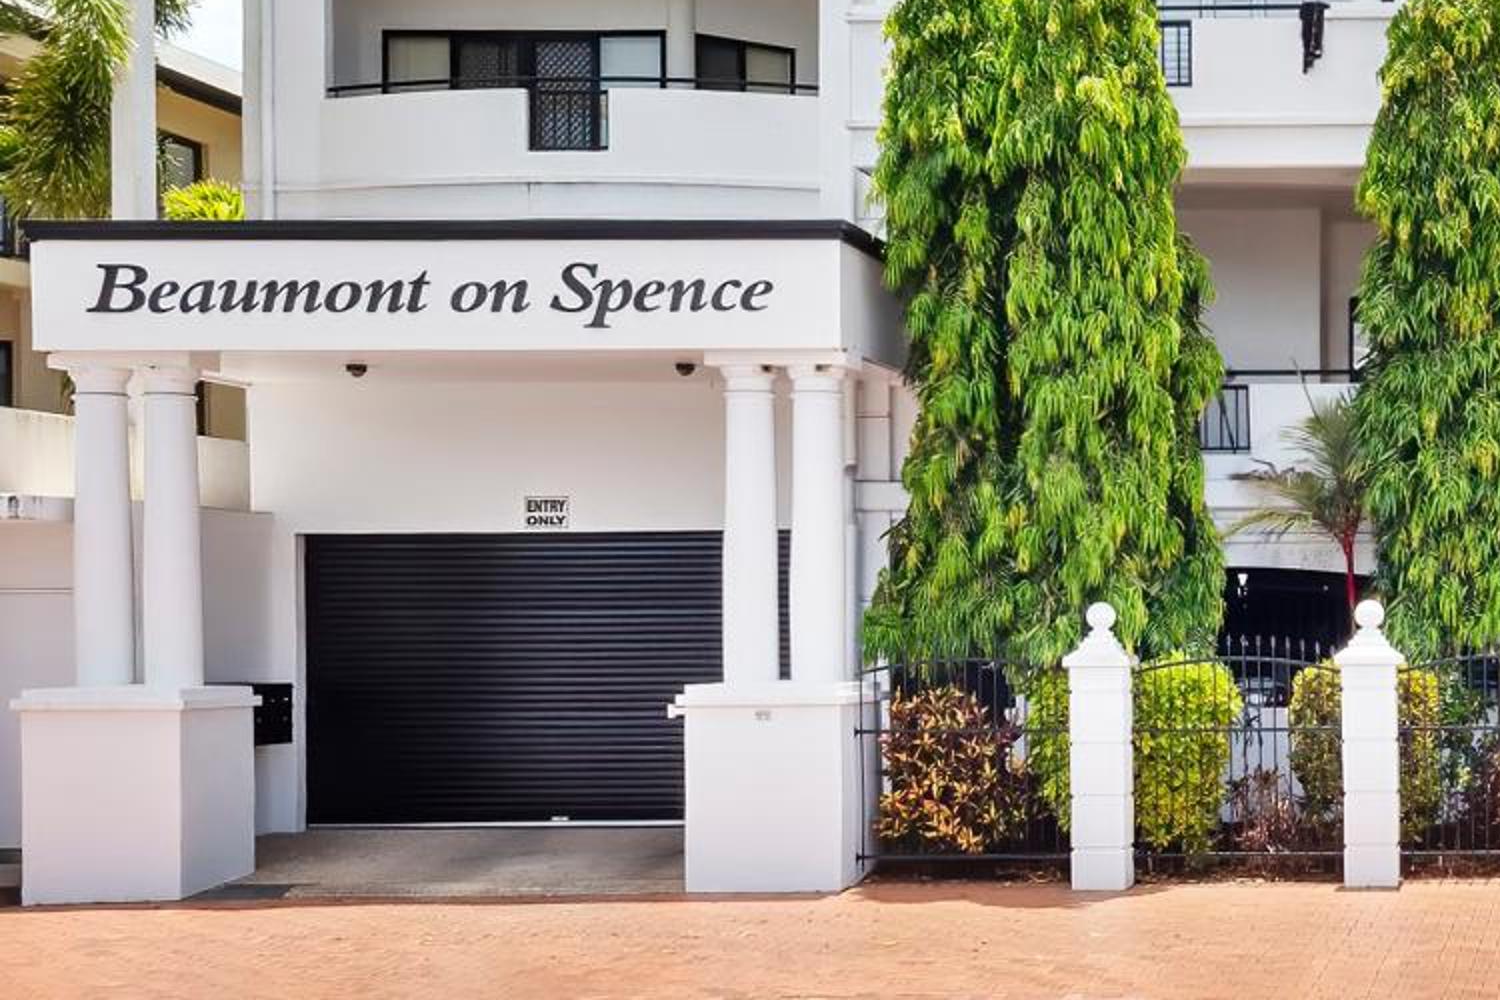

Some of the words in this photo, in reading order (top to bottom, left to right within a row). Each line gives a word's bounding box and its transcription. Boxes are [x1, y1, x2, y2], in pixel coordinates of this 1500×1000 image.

[86, 264, 430, 314] Beaumont
[450, 280, 530, 313] on
[550, 263, 774, 328] Spence
[527, 499, 567, 513] ENTRY
[526, 515, 566, 526] ONLY
